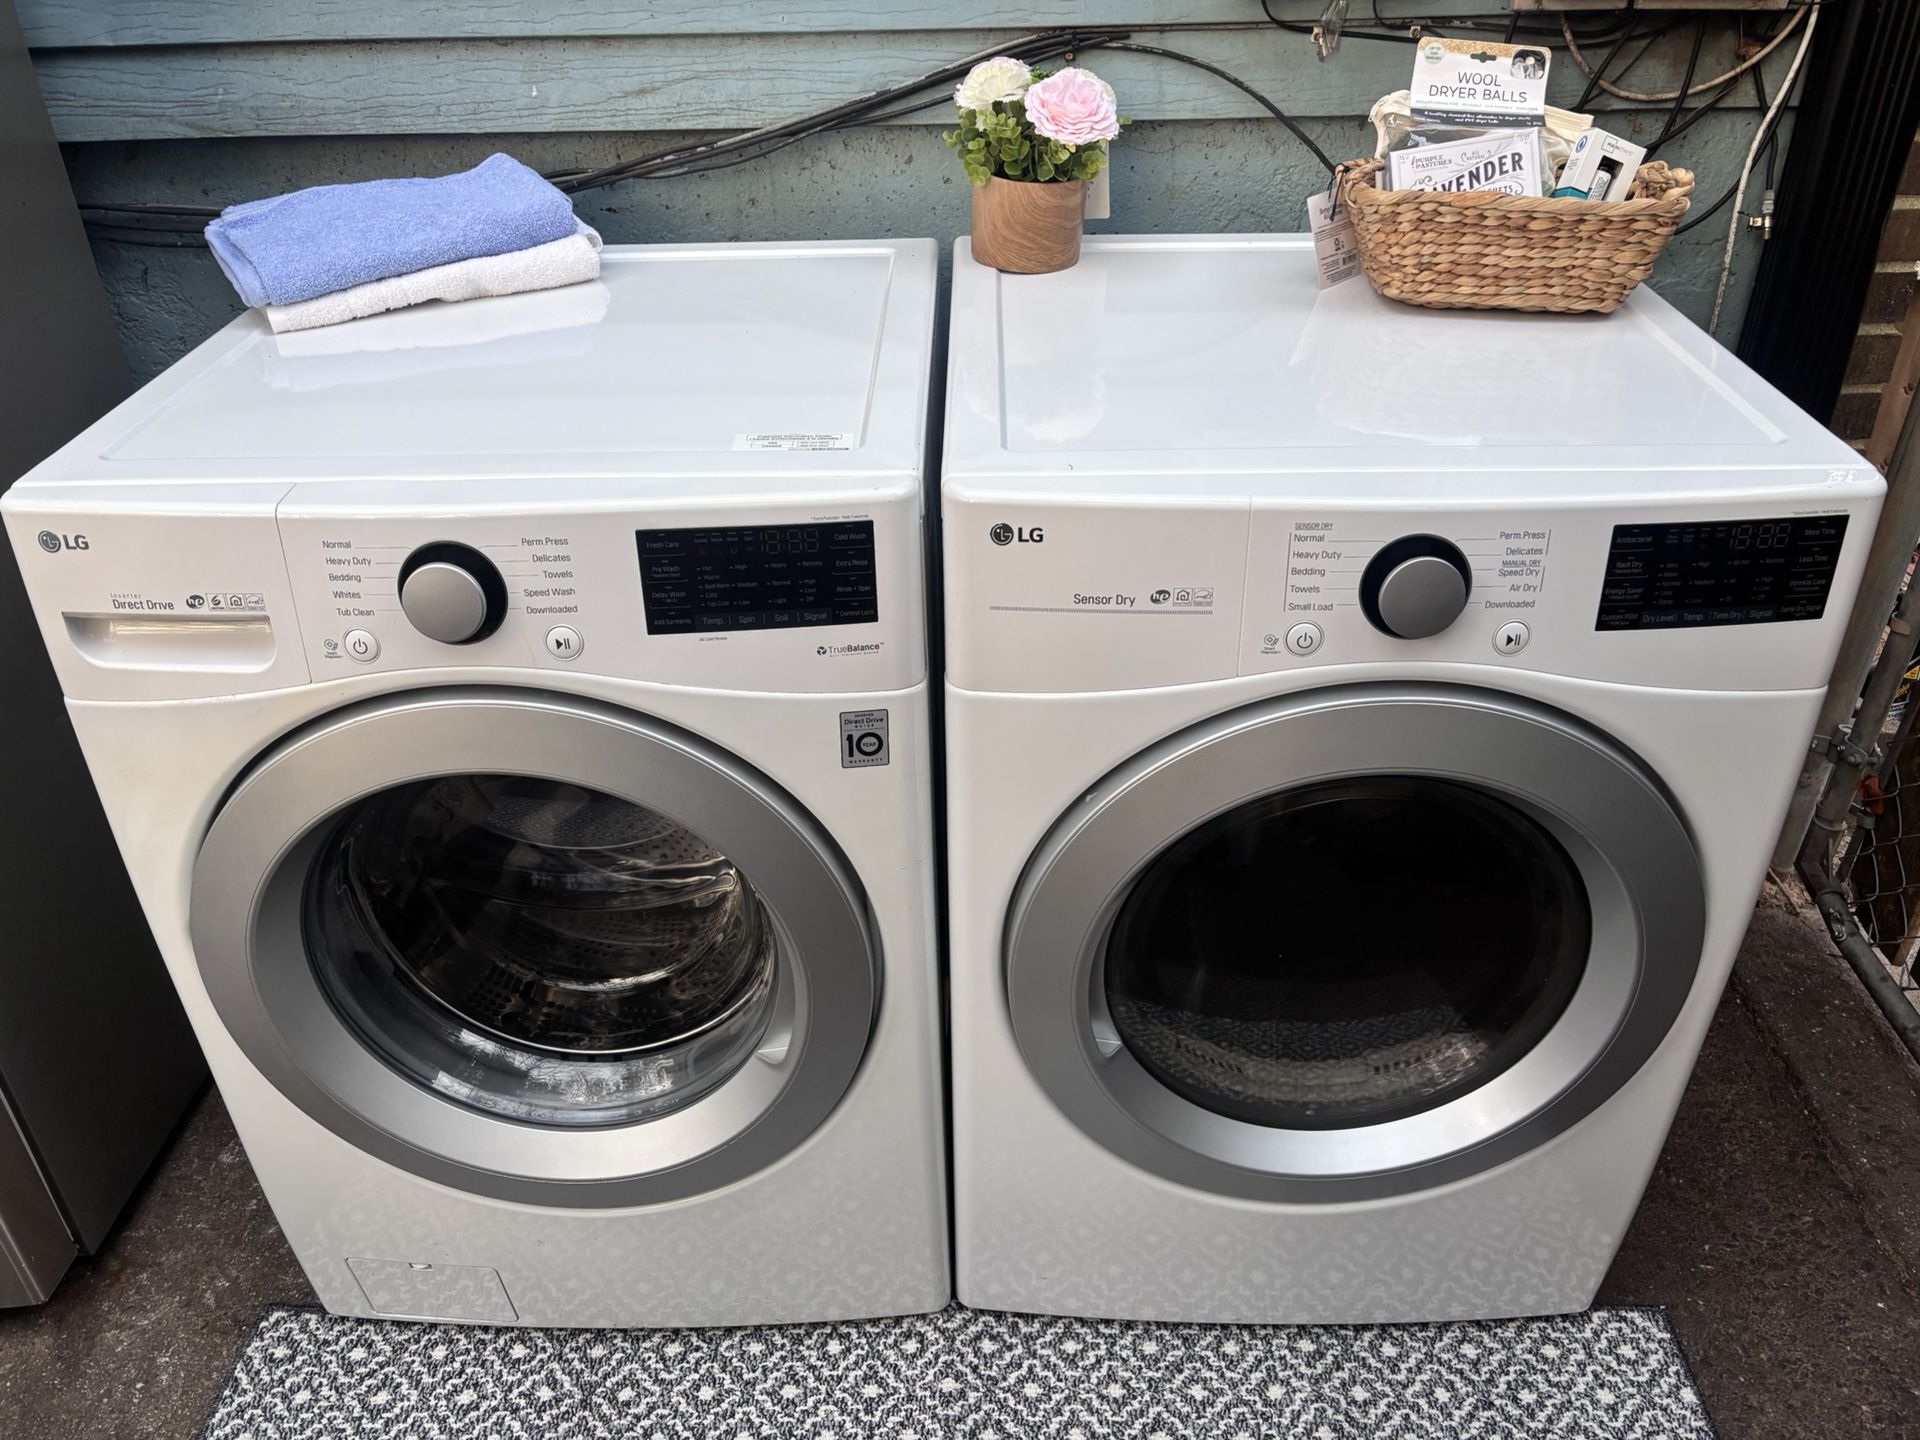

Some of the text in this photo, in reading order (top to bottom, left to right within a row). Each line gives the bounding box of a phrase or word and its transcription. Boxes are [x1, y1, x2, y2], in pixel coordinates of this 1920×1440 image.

[1458, 72, 1502, 86] WOOL
[1429, 85, 1527, 102] DRYER BALLS
[1415, 154, 1443, 164] PURPLE
[1416, 159, 1452, 169] PASTURES
[1417, 152, 1524, 192] VENDER
[1018, 527, 1044, 542] LG
[1294, 534, 1324, 543] Normal
[62, 534, 90, 550] LG
[322, 540, 352, 549] Normal
[1292, 551, 1342, 561] Heavy Duty
[1506, 547, 1543, 556] Delicates
[326, 557, 371, 566] Heavy Duty
[532, 554, 571, 563] Delicates
[542, 570, 573, 579] Towels
[1291, 567, 1326, 577] Bedding
[1498, 568, 1540, 578] Speed Dry
[328, 573, 361, 583] Bedding
[524, 587, 575, 597] Speed Wash
[1290, 584, 1320, 594] Towels
[1509, 583, 1538, 593] Air Dry
[332, 591, 361, 599] Whites
[112, 599, 175, 610] Direct Drive
[1073, 593, 1136, 608] Sensor Dry
[1484, 600, 1535, 609] Downloaded
[526, 605, 578, 614] Downloaded
[1288, 602, 1333, 611] Small Load
[337, 608, 375, 616] Tub Clean
[804, 612, 827, 622] Signal
[1683, 613, 1704, 621] Temp.
[1730, 611, 1742, 620] Dry
[1750, 609, 1774, 618] Signal
[703, 617, 726, 626] Temp.
[739, 616, 756, 625] Spin
[1643, 615, 1655, 623] Dry
[846, 732, 883, 757] 10
